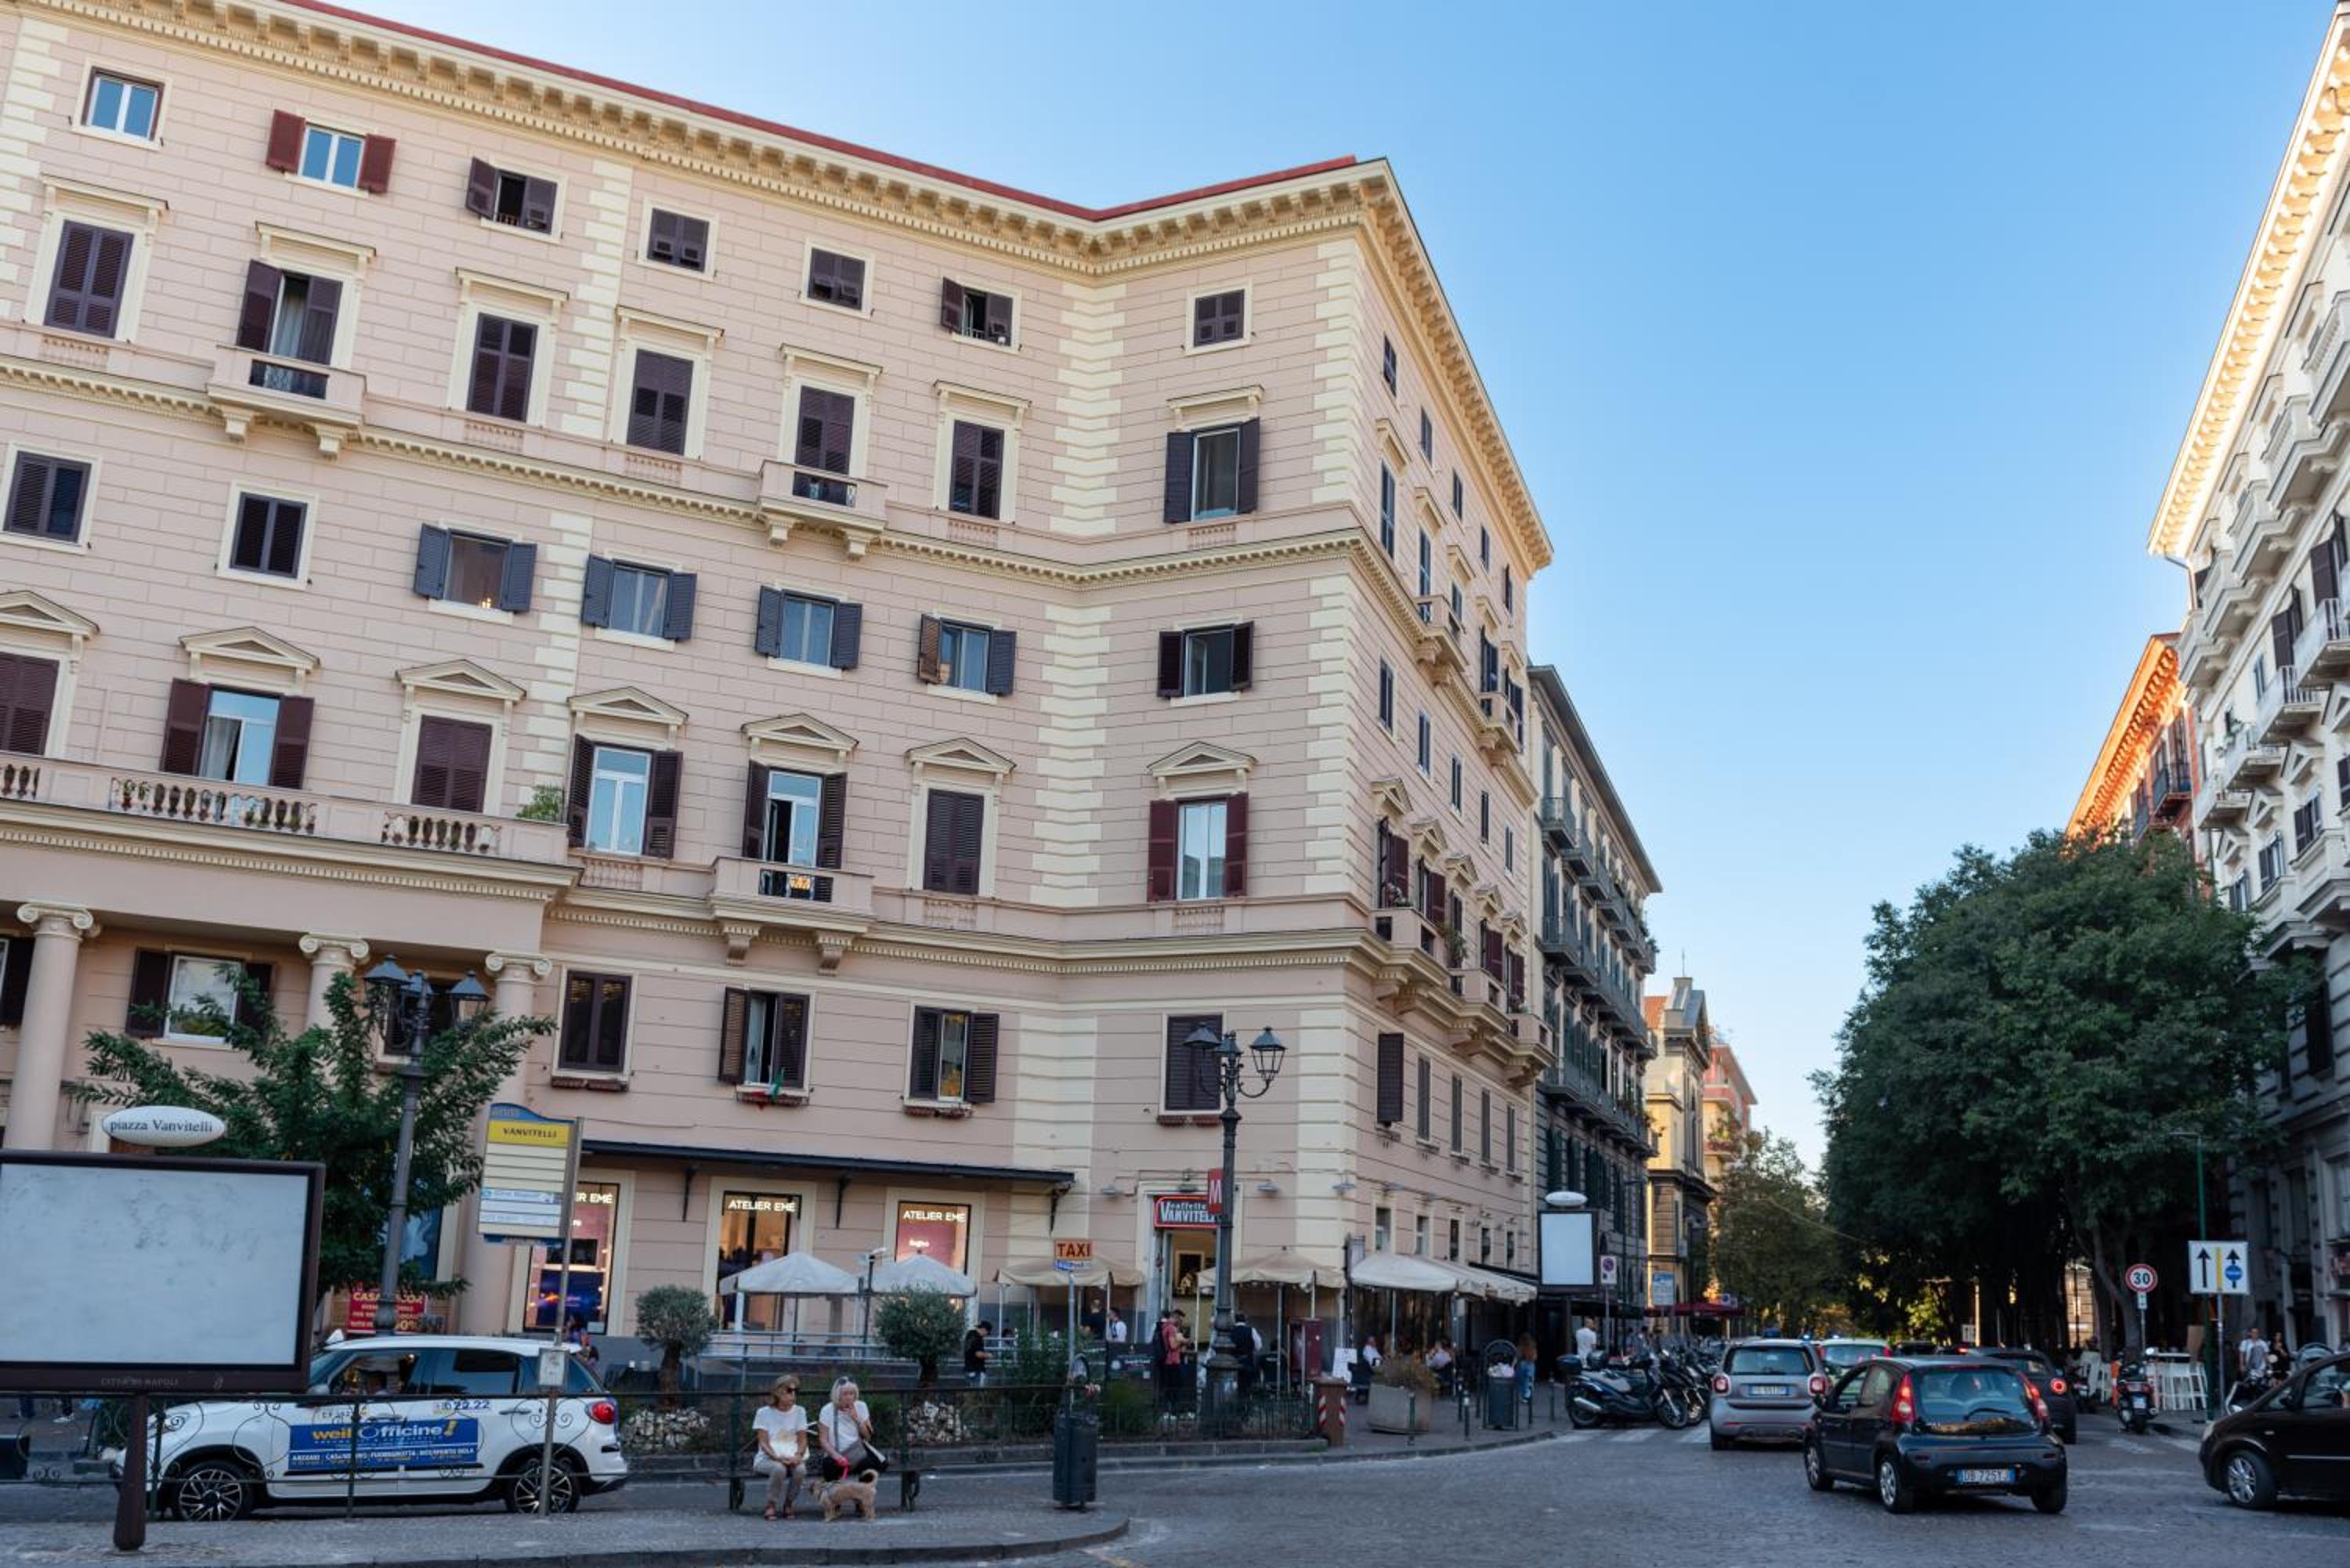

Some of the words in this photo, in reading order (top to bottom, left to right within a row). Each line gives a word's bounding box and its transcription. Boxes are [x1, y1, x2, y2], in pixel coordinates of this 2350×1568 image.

[110, 1119, 148, 1133] piazza
[152, 1119, 213, 1133] Vanvitelli
[503, 1128, 557, 1138] VANVITELLI
[1209, 1179, 1222, 1205] M
[728, 1199, 772, 1211] ATELIER
[903, 1210, 942, 1221] ATELIER
[1057, 1243, 1090, 1257] TAXI
[2133, 1271, 2150, 1285] 30
